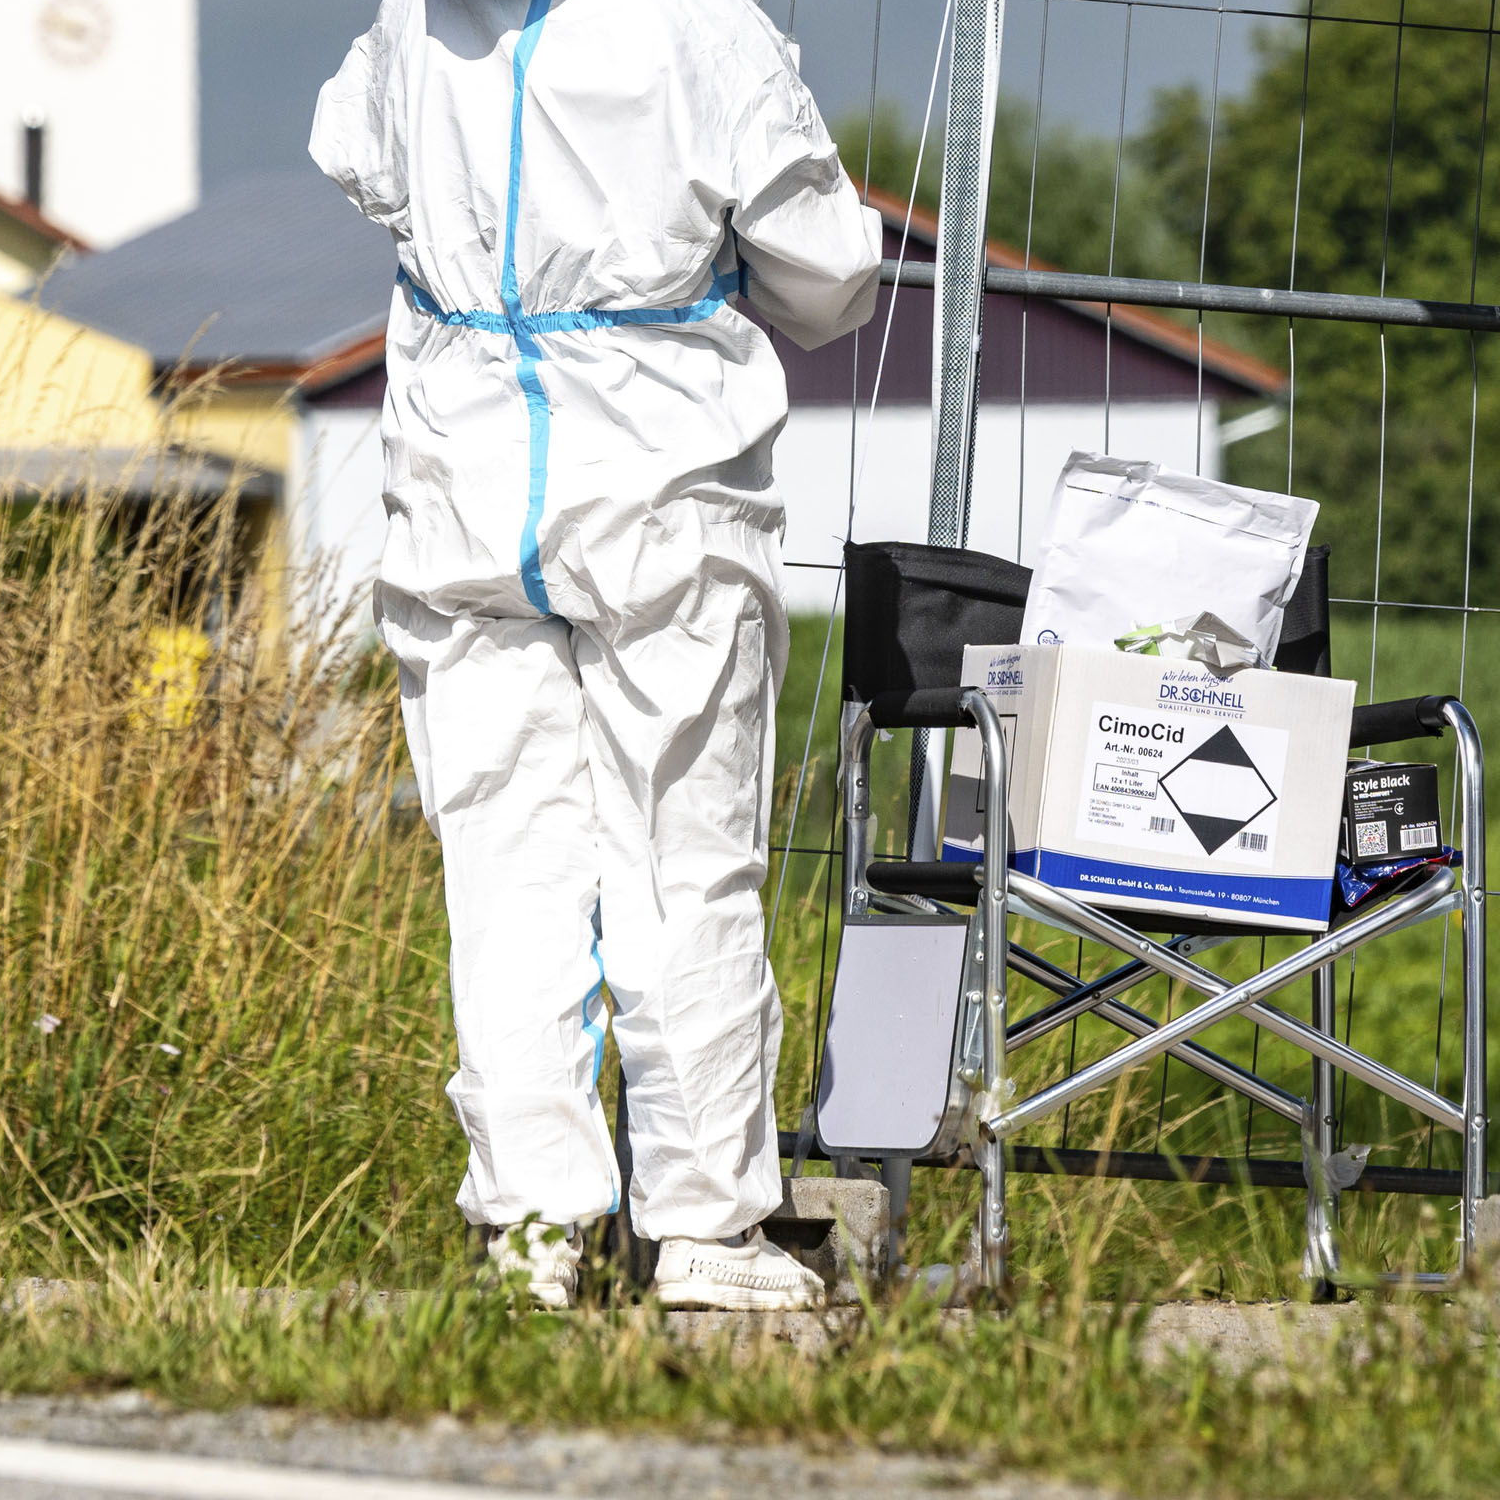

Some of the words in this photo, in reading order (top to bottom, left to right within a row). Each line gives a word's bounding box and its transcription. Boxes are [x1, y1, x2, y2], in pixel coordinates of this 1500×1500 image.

[1162, 670, 1177, 681] Wir
[1178, 669, 1198, 682] leben
[1160, 684, 1244, 708] DR.SCHNELL
[1214, 711, 1243, 719] SERVICE
[1098, 714, 1185, 744] CimoCid
[1104, 741, 1135, 755] Art.-Nr.
[1138, 747, 1163, 758] 00624
[1121, 769, 1139, 778] Inhalt
[1096, 783, 1109, 791] EAN
[1129, 779, 1143, 787] Liter
[1352, 778, 1378, 793] Style
[1380, 774, 1411, 788] Black
[1080, 873, 1116, 885] DR.SCHNELL
[1117, 878, 1136, 888] GmbH
[1137, 881, 1142, 889] &
[1144, 882, 1154, 890] Co.
[1155, 883, 1173, 892] KGaA
[1179, 886, 1216, 898] Taunusstraße
[1231, 893, 1252, 902] 80807
[1252, 896, 1280, 906] München
